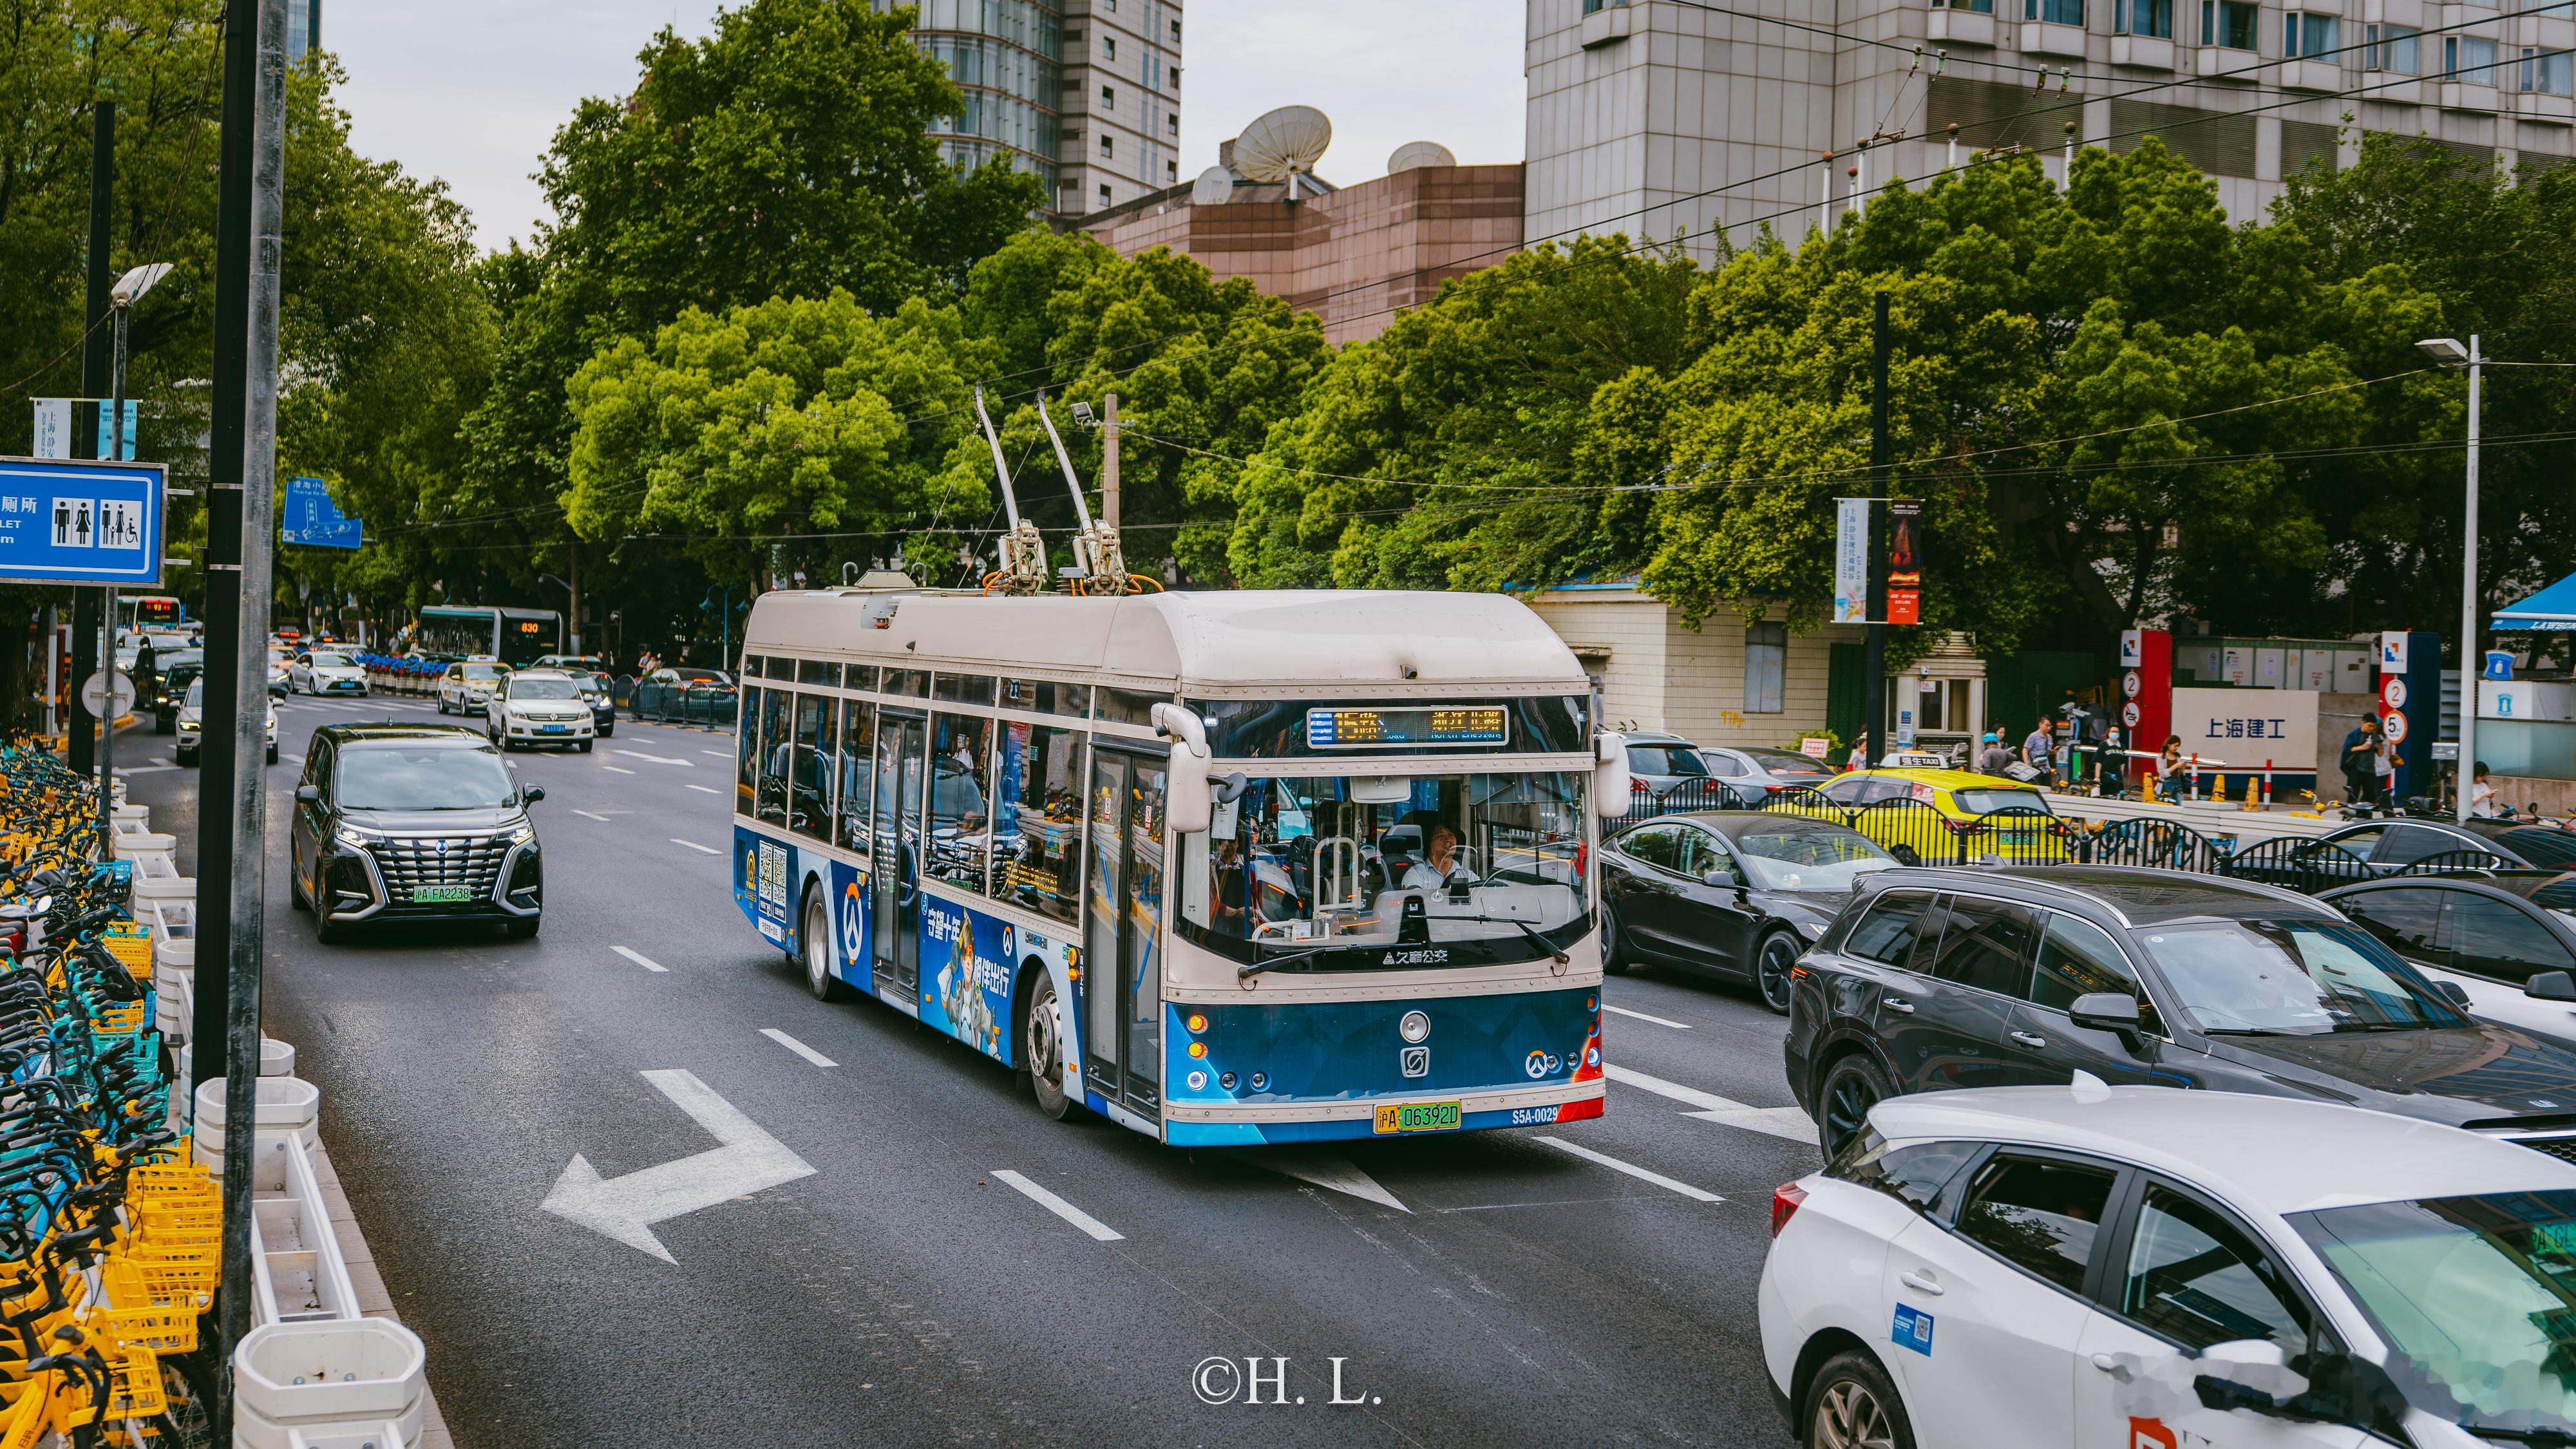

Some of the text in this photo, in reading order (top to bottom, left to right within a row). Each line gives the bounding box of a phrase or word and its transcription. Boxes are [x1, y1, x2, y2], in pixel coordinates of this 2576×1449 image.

[1, 496, 37, 514] 厕所
[522, 623, 538, 632] 830
[2128, 677, 2135, 692] 2
[2392, 686, 2400, 701] 2
[2206, 718, 2286, 739] 上海建工
[2389, 717, 2396, 733] 5
[433, 889, 469, 899] FA2238
[927, 908, 961, 943] 守望十年
[1396, 949, 1448, 964] 久事公交
[972, 954, 1010, 998] 相伴出行
[1379, 1106, 1459, 1128] 沪A 06392D
[1513, 1107, 1558, 1124] S5A-0029
